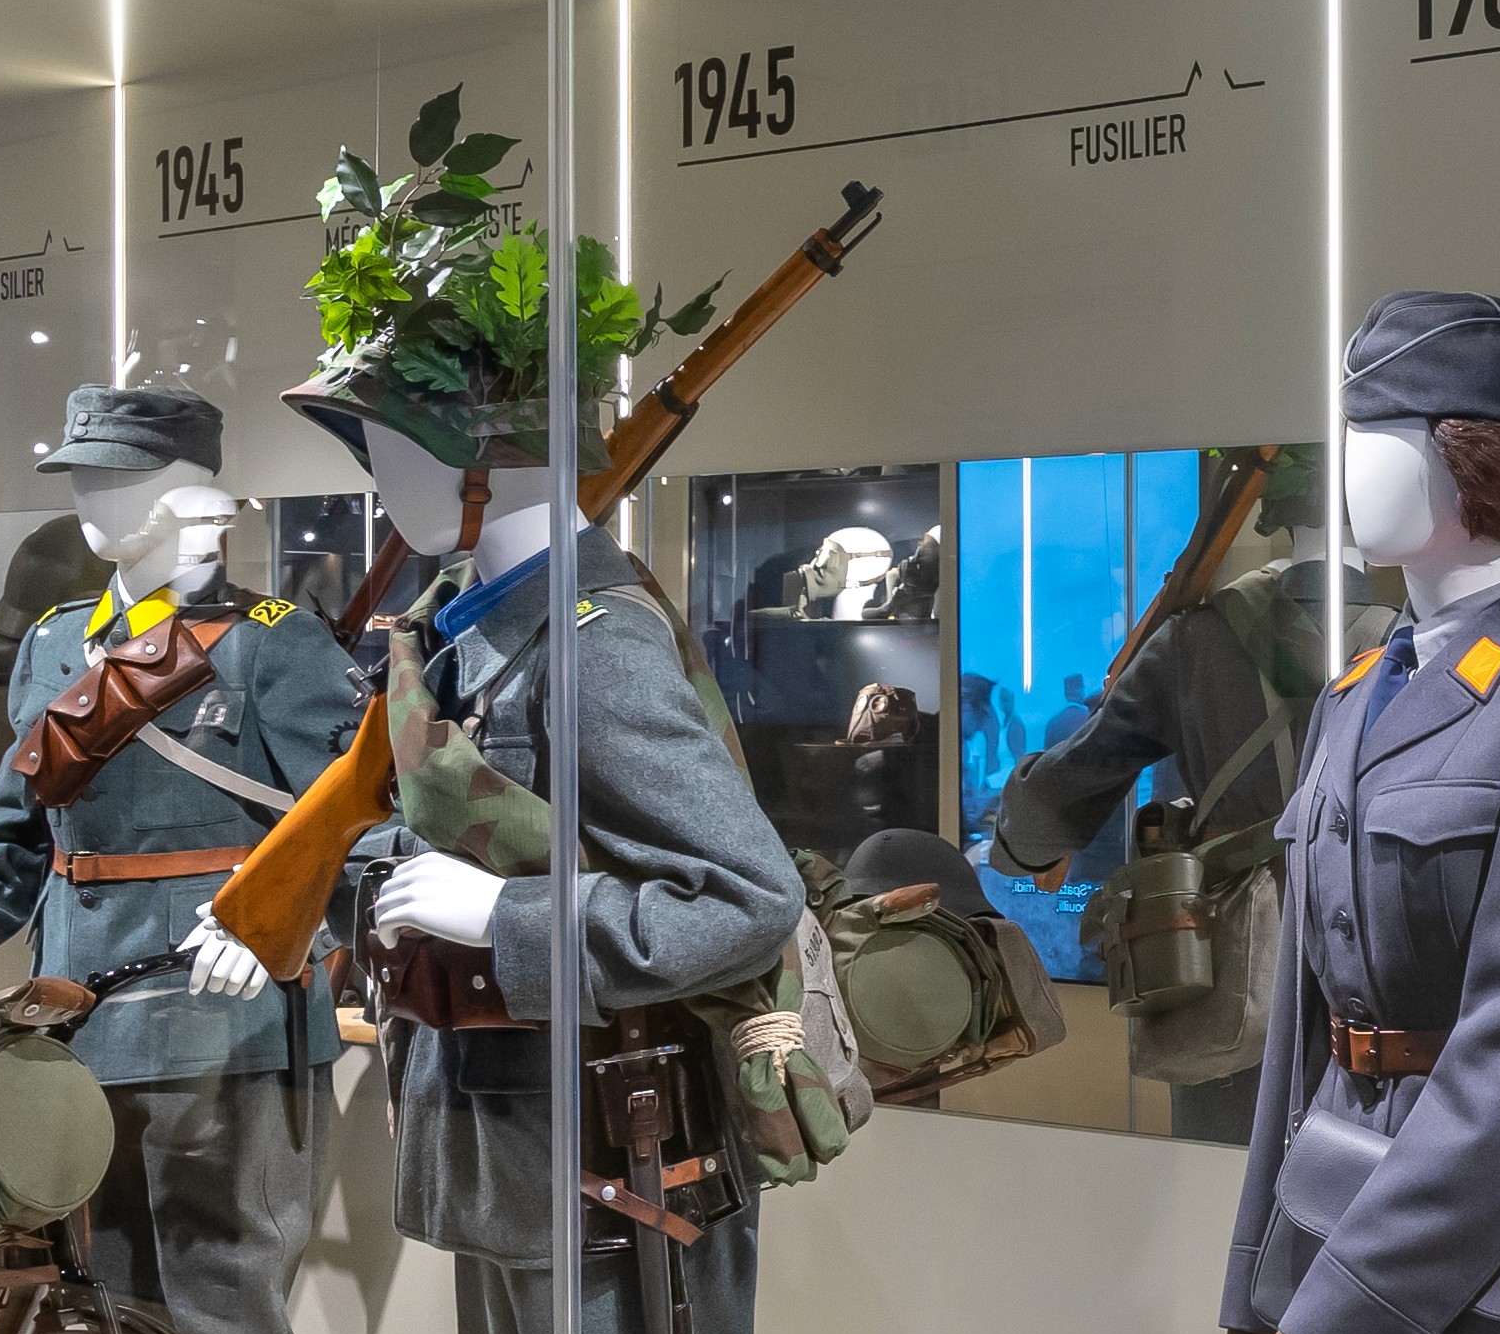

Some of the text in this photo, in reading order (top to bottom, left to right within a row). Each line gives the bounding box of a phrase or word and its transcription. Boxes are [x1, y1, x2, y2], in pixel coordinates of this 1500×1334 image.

[674, 45, 795, 149] 1945
[1070, 114, 1187, 167] FUSILIER
[156, 137, 244, 223] 1945
[253, 600, 291, 624] 23
